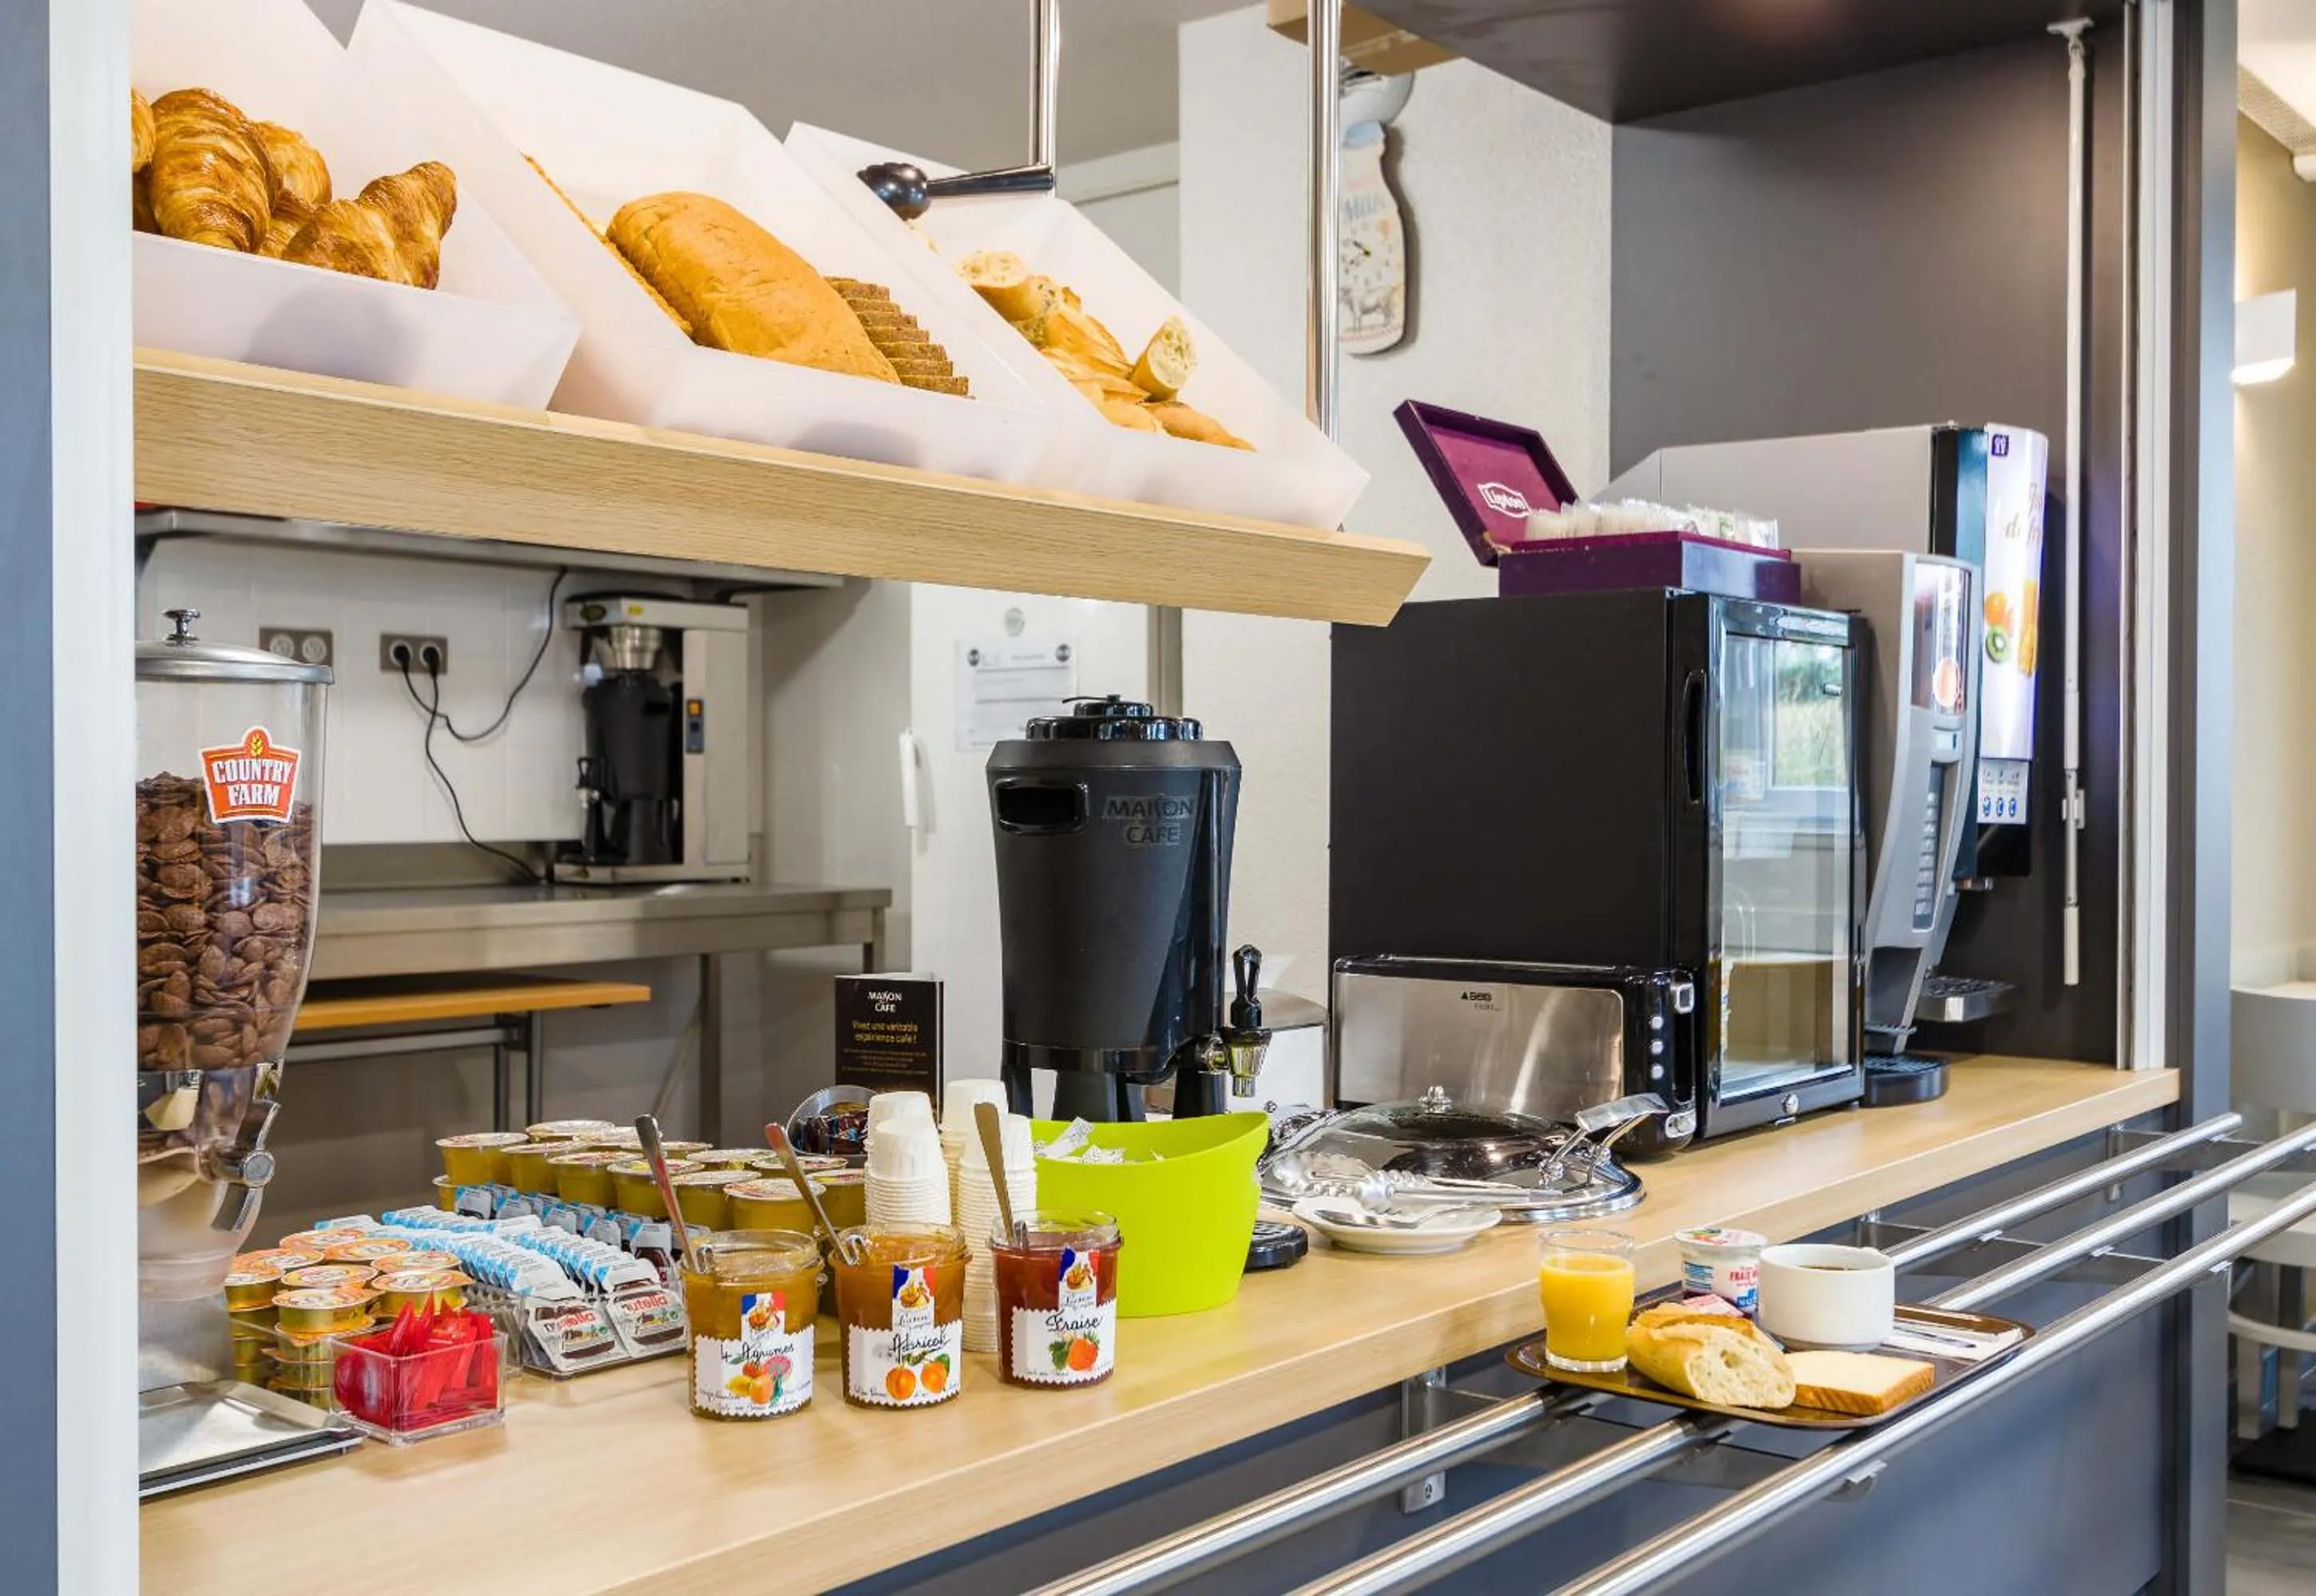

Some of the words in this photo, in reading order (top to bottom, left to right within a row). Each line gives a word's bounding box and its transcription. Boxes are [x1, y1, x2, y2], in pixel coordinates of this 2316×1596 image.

[1485, 489, 1526, 509] Lipton
[212, 758, 293, 784] COUNTRY
[228, 782, 280, 806] FARM
[621, 1295, 668, 1312] nutella
[544, 1311, 596, 1333] nutella
[1045, 1309, 1104, 1333] Fraise
[741, 1341, 795, 1371] Agrumes
[888, 1324, 950, 1364] Abricot
